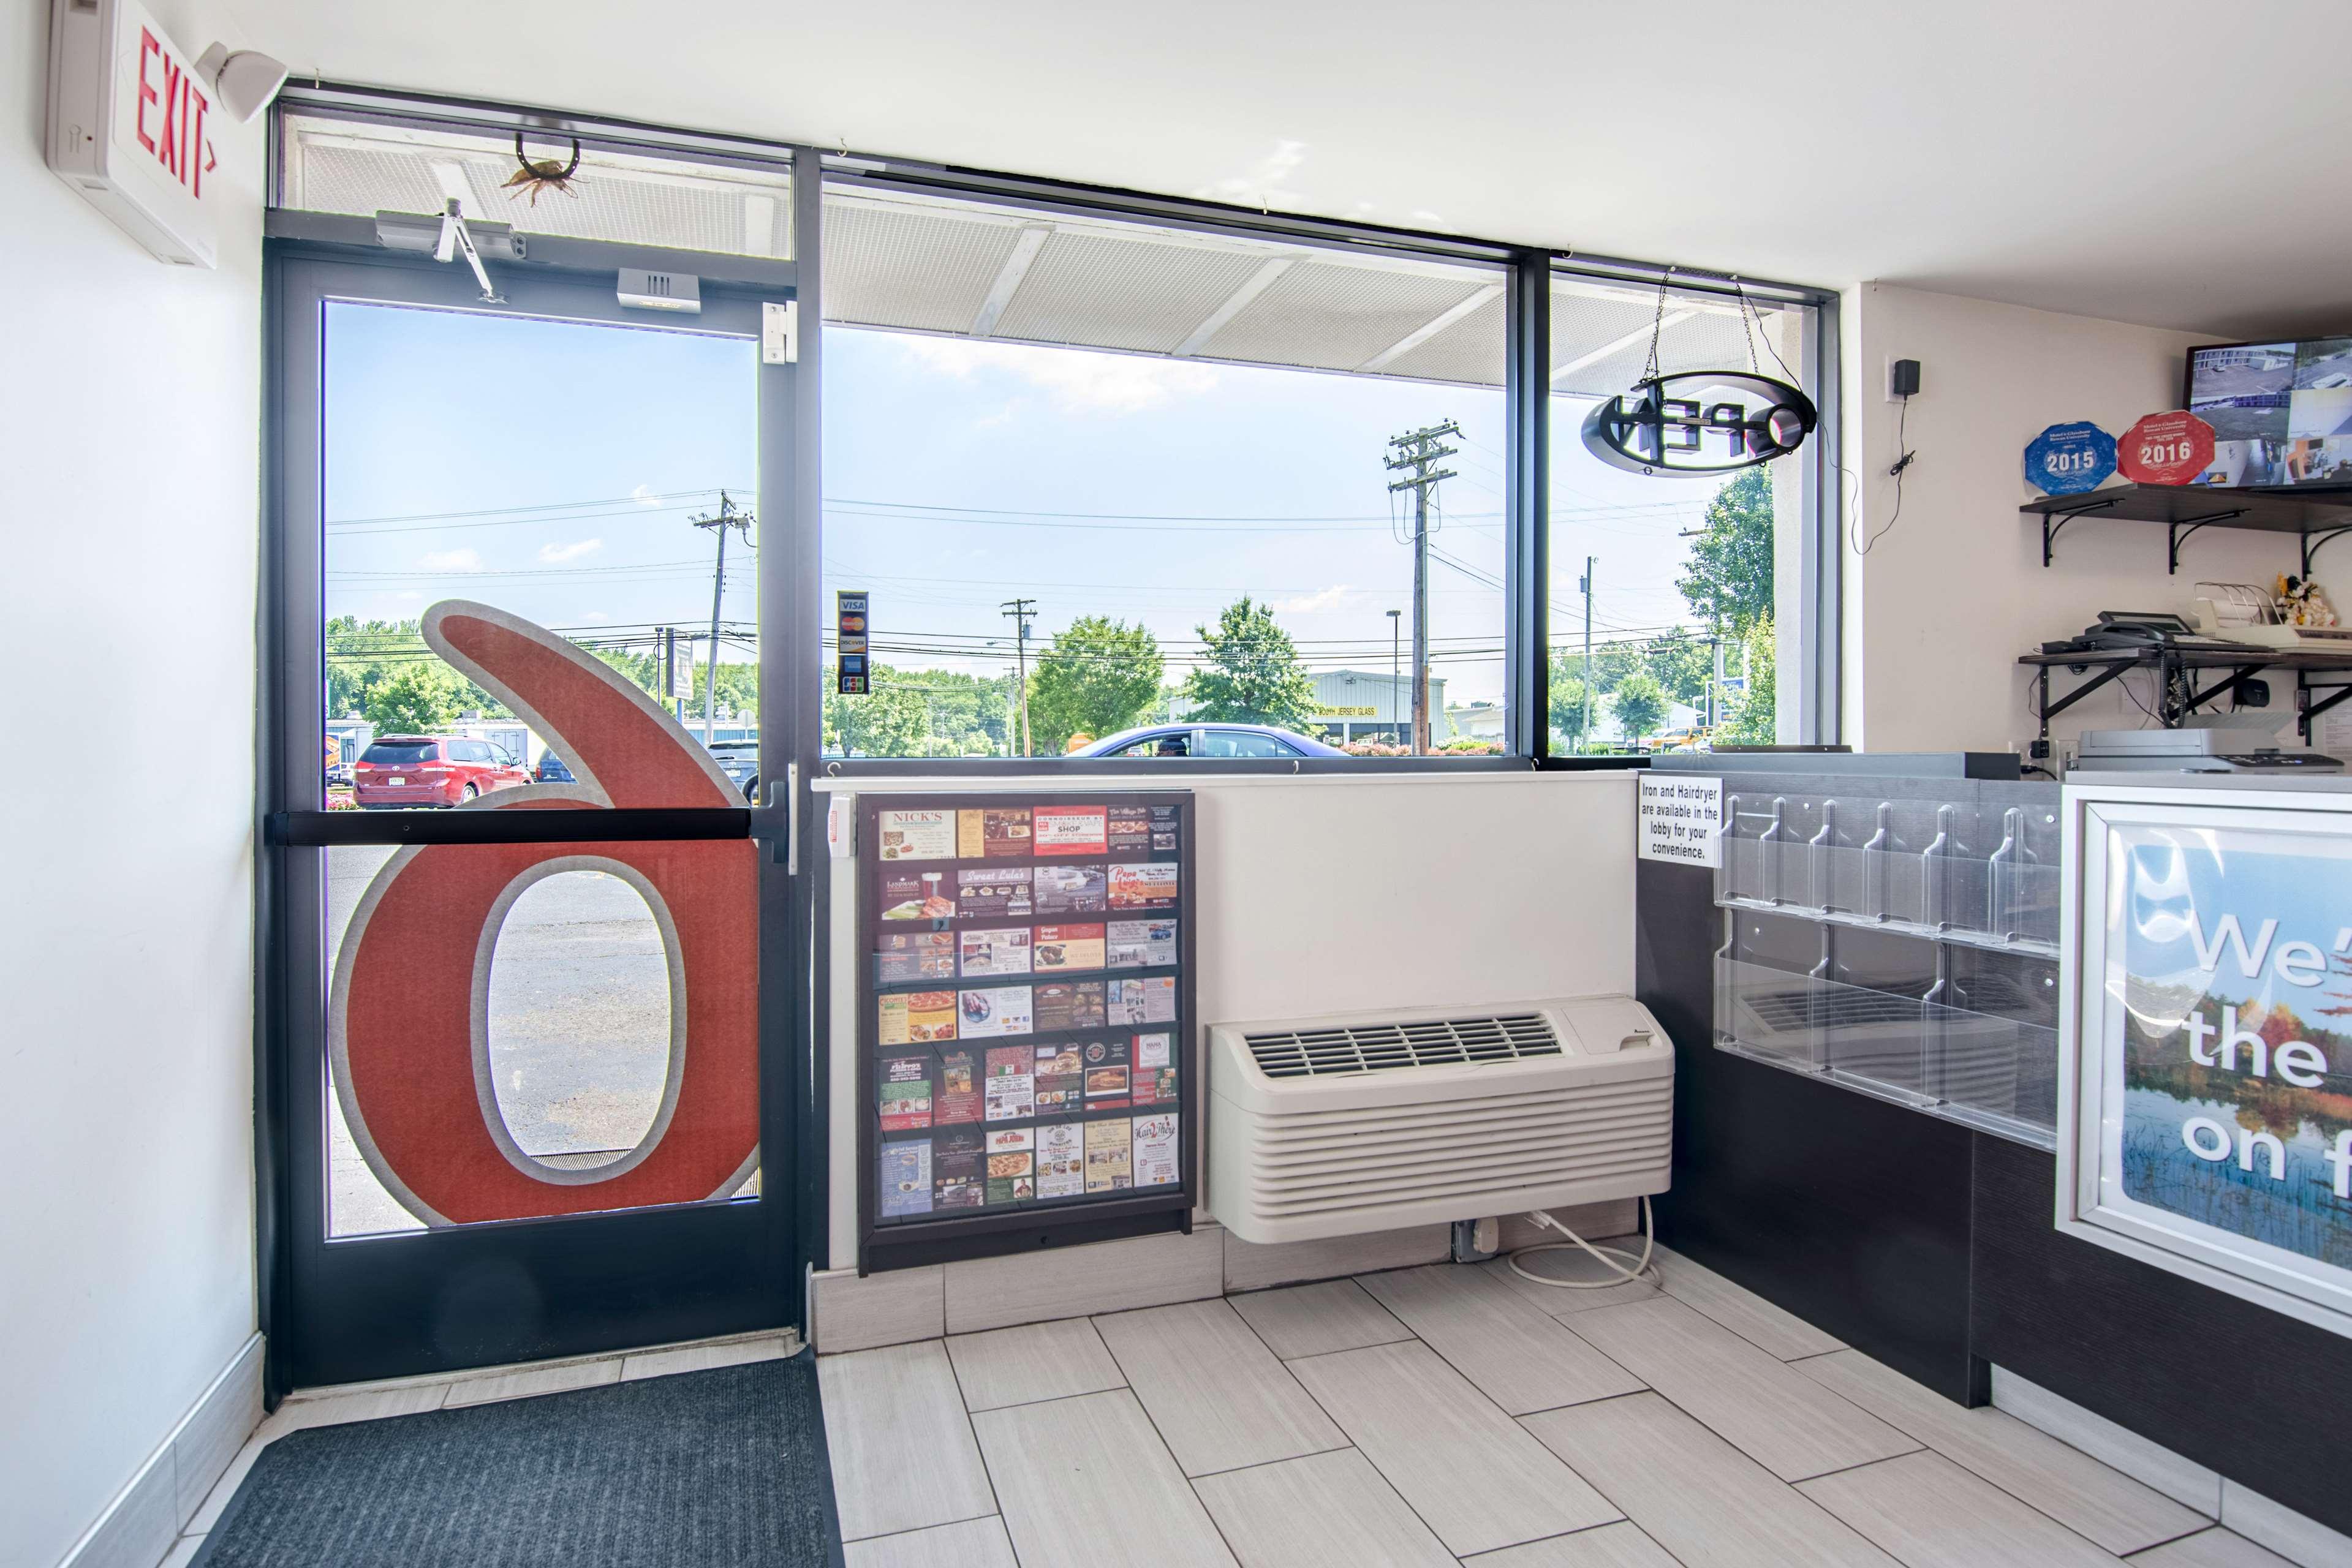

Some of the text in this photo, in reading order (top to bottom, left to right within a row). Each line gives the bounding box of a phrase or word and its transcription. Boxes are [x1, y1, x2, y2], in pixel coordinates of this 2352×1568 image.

[137, 25, 209, 200] EXIT
[2048, 451, 2094, 472] 2015
[2141, 442, 2191, 464] 2016
[1643, 783, 1717, 803] Iron and Hairdryer
[894, 813, 942, 821] NICK'S
[1642, 804, 1717, 820] are available in the
[1651, 821, 1707, 841] lobby for your
[1652, 843, 1705, 859] convenience.
[966, 871, 996, 881] Sweet
[2182, 1005, 2328, 1088] the
[2182, 1116, 2286, 1181] on
